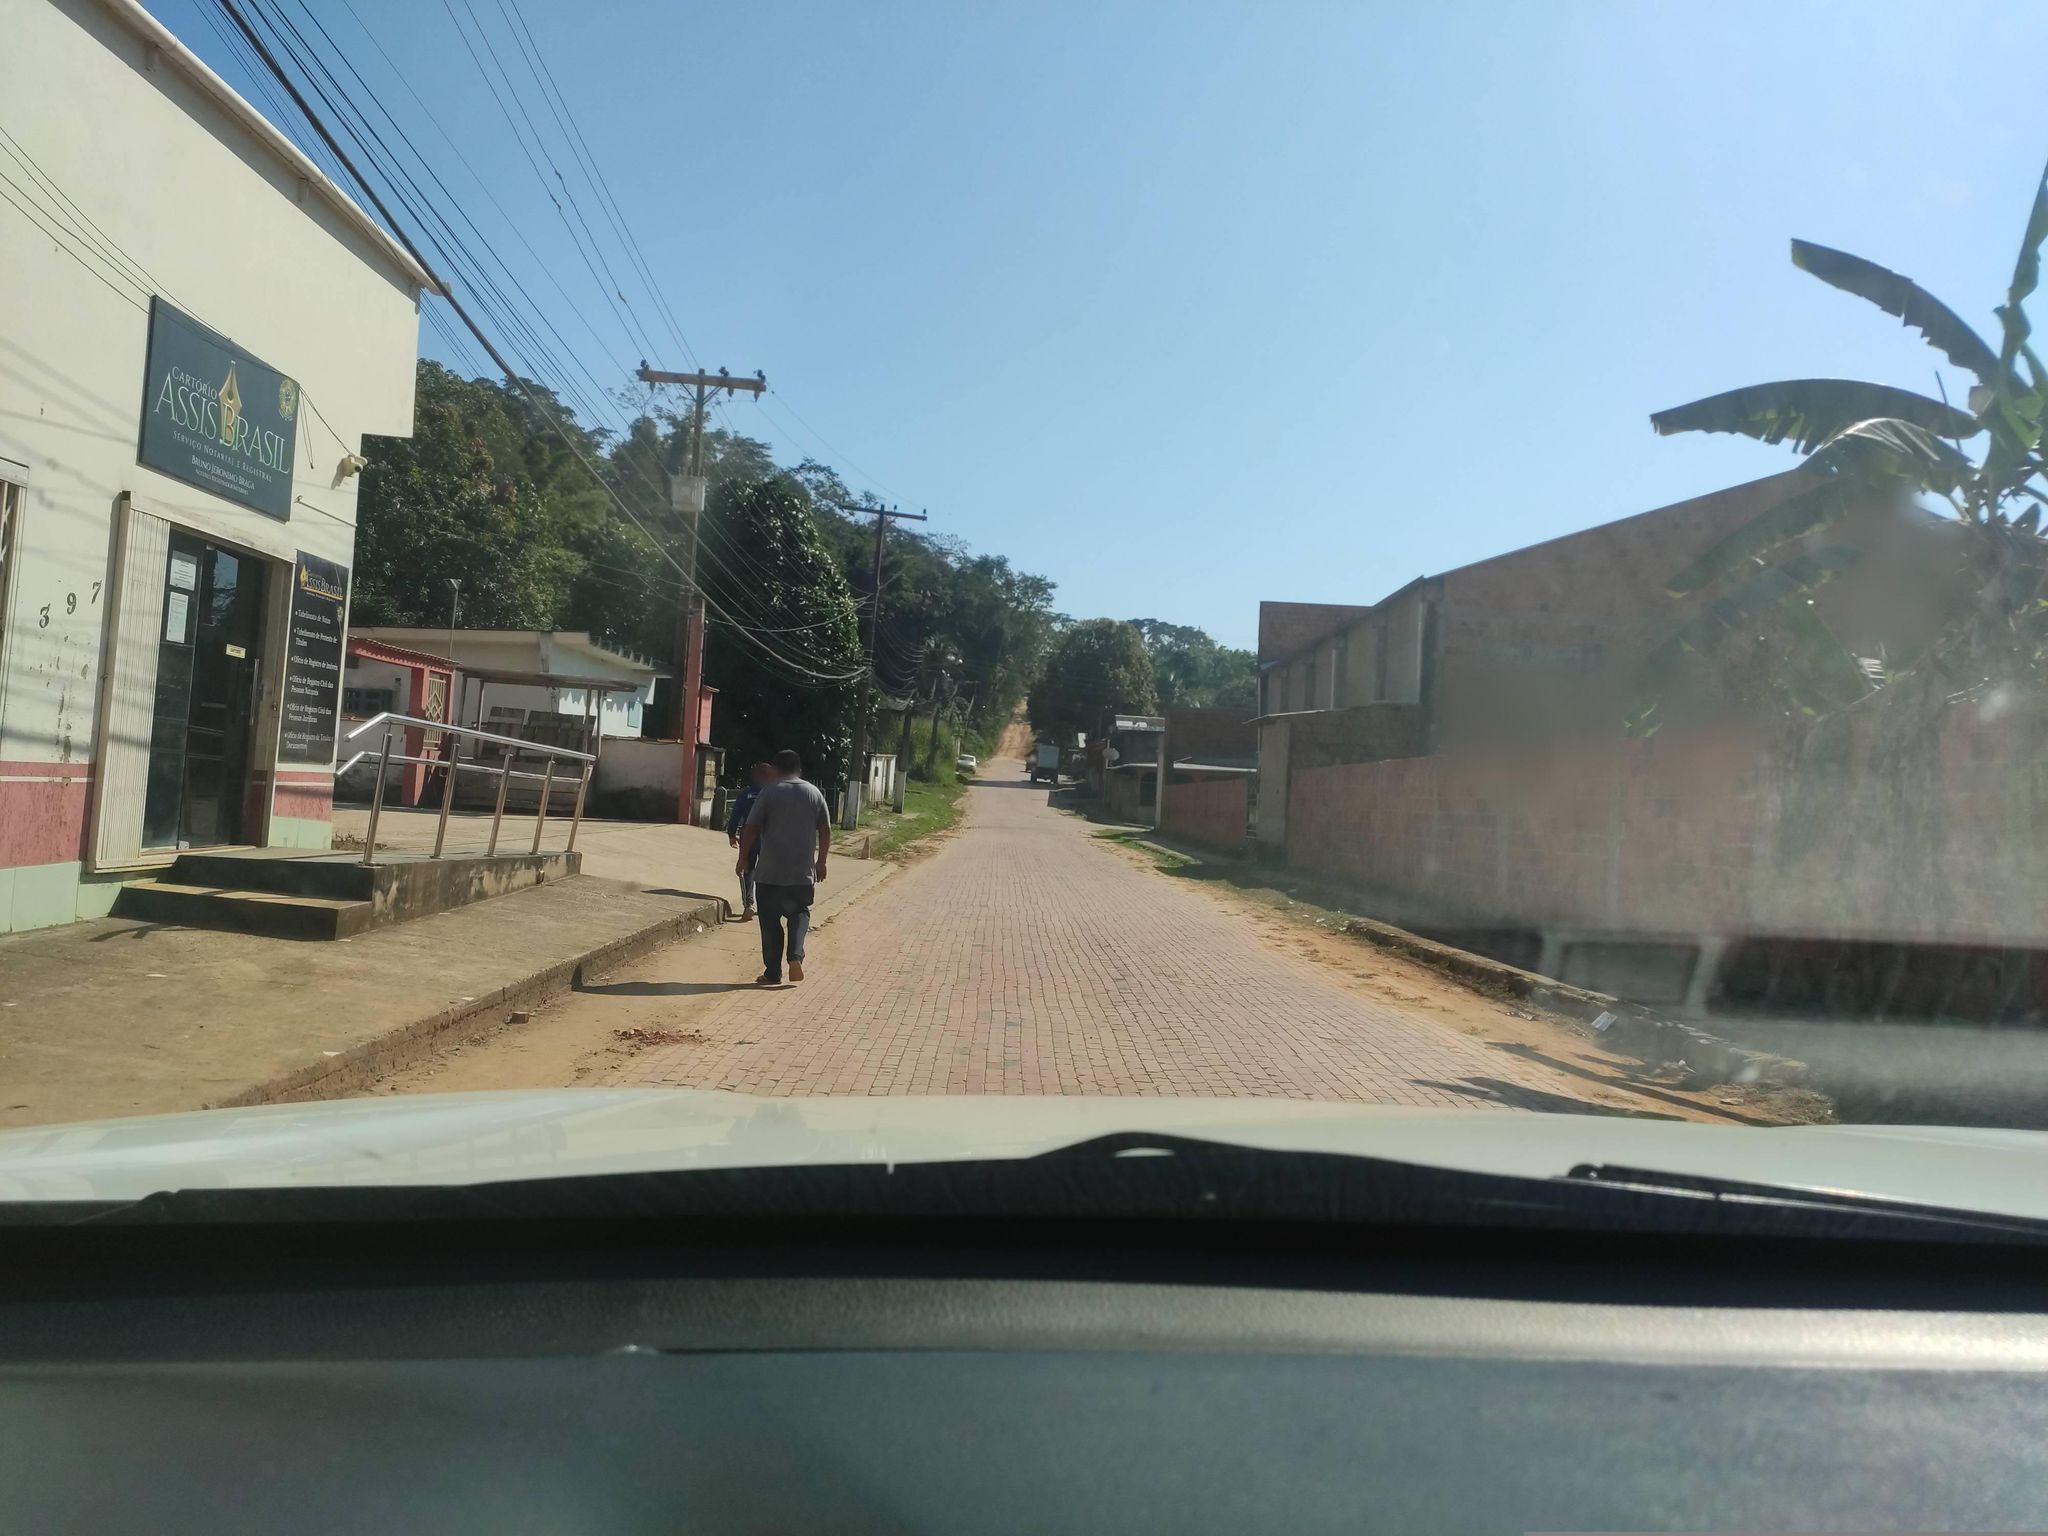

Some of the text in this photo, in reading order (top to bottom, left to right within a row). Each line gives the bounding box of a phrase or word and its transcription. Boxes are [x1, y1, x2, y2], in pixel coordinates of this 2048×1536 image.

[172, 366, 217, 400] CARTÓRIO
[153, 372, 290, 474] ASSIS BRASIL
[173, 430, 202, 450] SERVIÇO
[191, 454, 212, 471] BRUNO
[238, 475, 255, 490] BRAGA
[39, 579, 103, 629] 397
[320, 577, 344, 598] BRASIL
